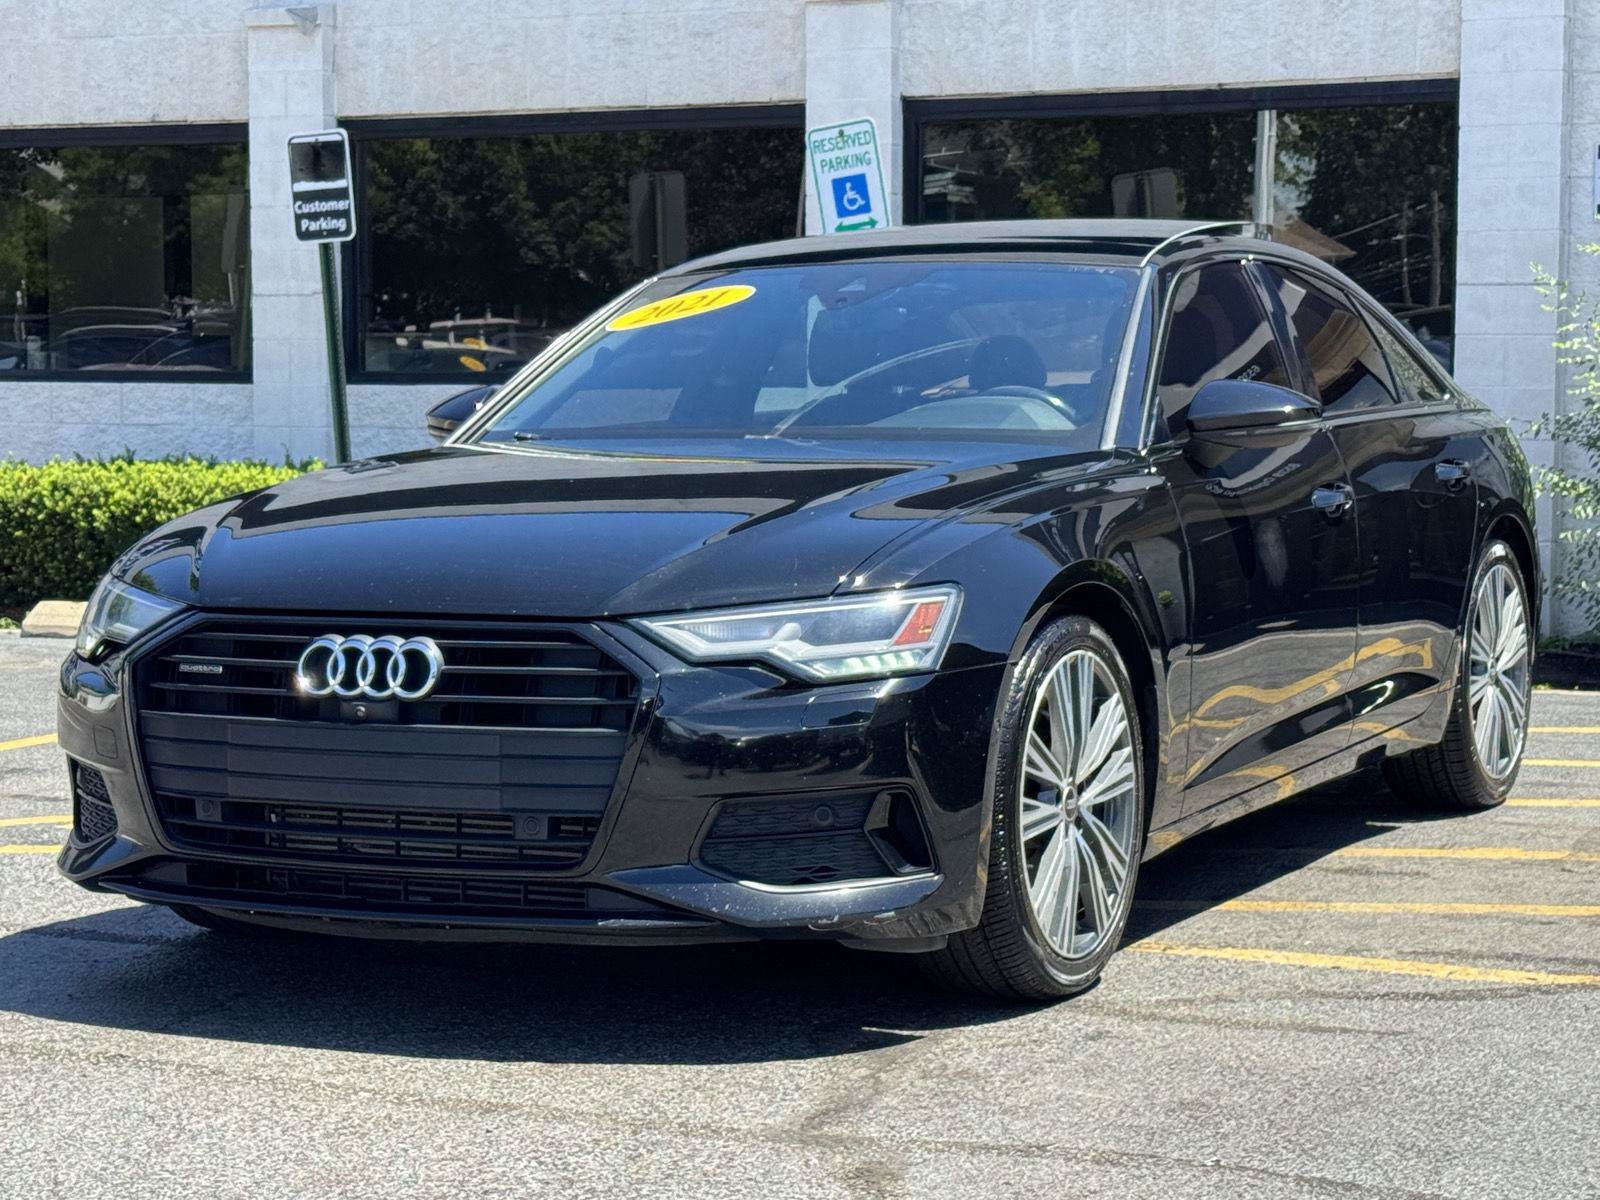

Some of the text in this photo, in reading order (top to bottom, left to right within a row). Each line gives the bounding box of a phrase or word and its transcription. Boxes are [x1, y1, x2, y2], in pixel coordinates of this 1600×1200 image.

[813, 131, 871, 153] RESERVED
[821, 152, 871, 173] PARKING
[295, 200, 350, 214] Customer
[301, 217, 346, 232] Parking
[630, 291, 730, 324] 2021
